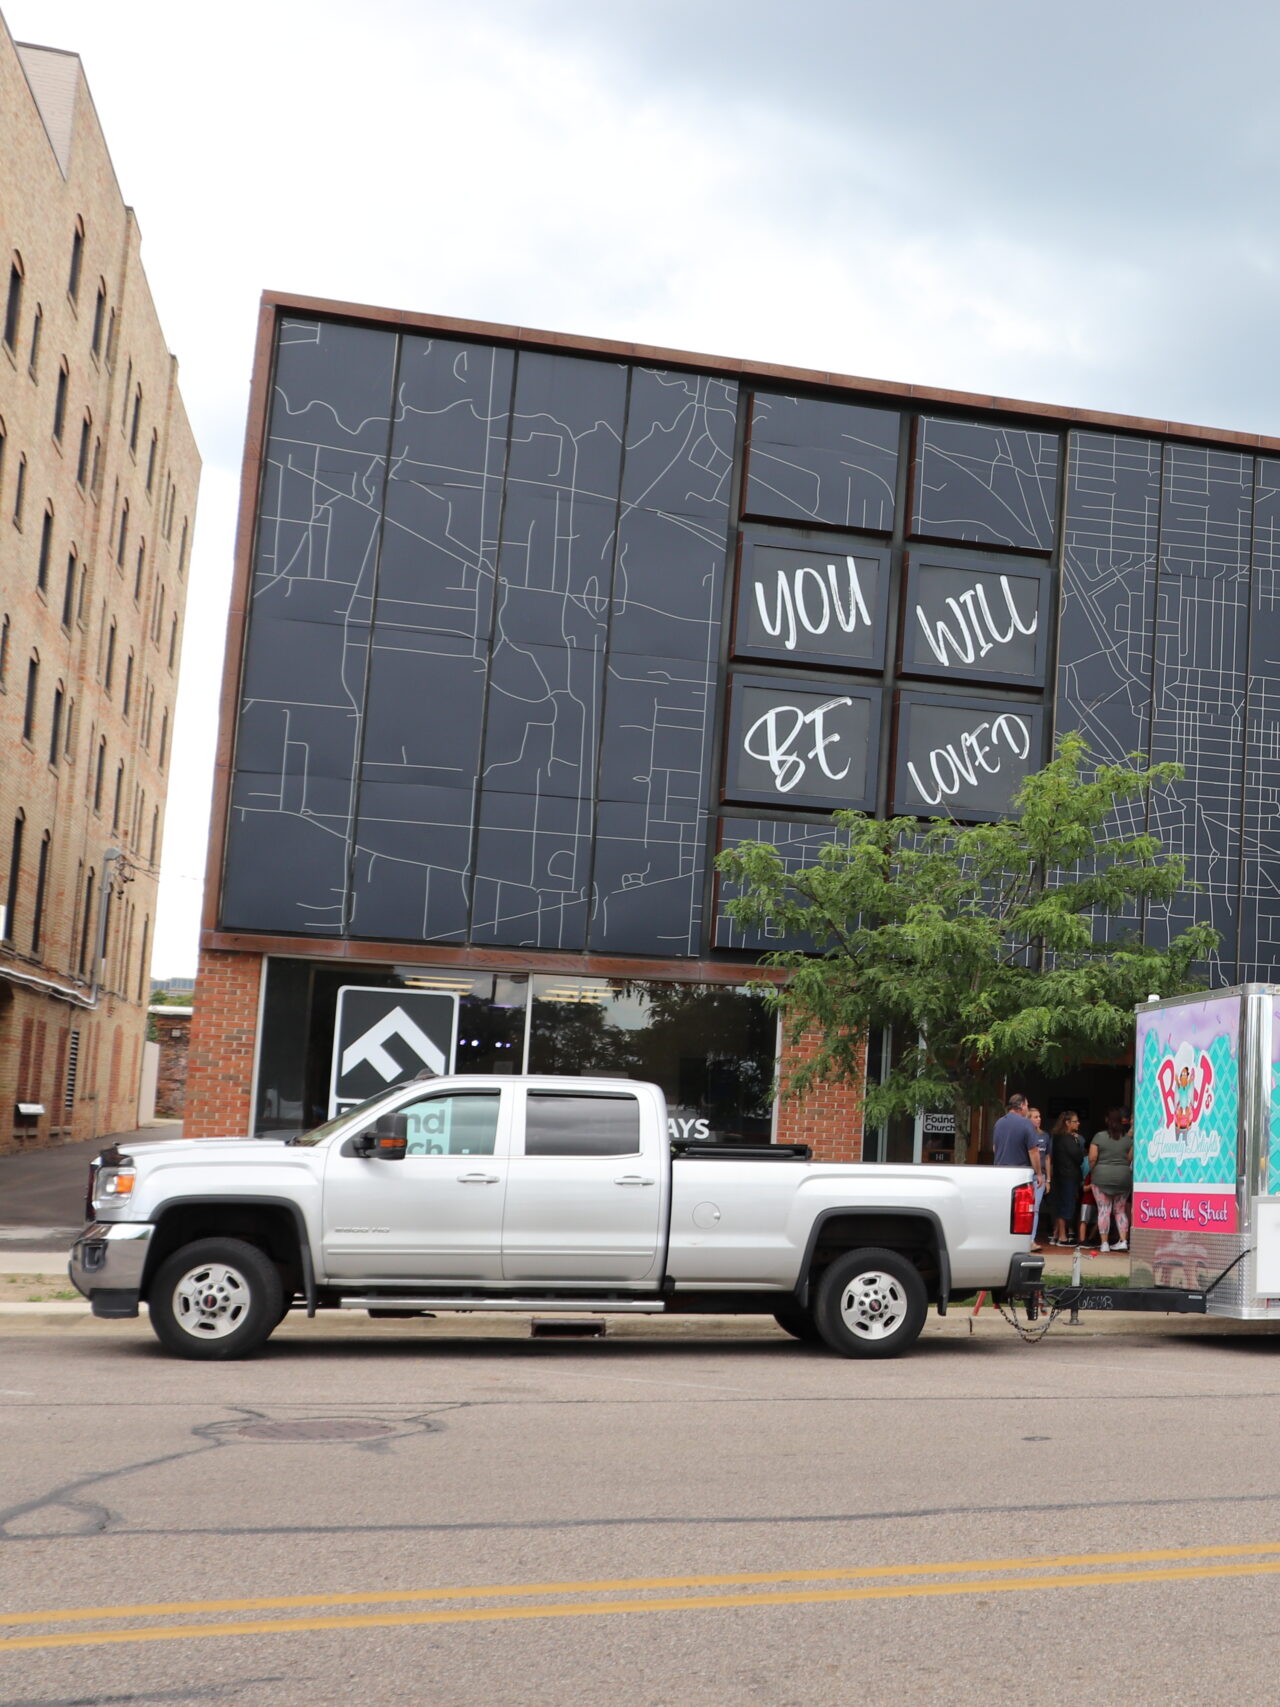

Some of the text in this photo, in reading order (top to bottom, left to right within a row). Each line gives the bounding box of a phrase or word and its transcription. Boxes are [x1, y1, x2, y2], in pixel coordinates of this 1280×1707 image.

[755, 556, 1038, 667] YOU WILL
[744, 696, 1030, 806] BE LOVED
[668, 1118, 710, 1139] AYS
[925, 1123, 955, 1131] Church
[1140, 1199, 1228, 1226] Sweets on the Street
